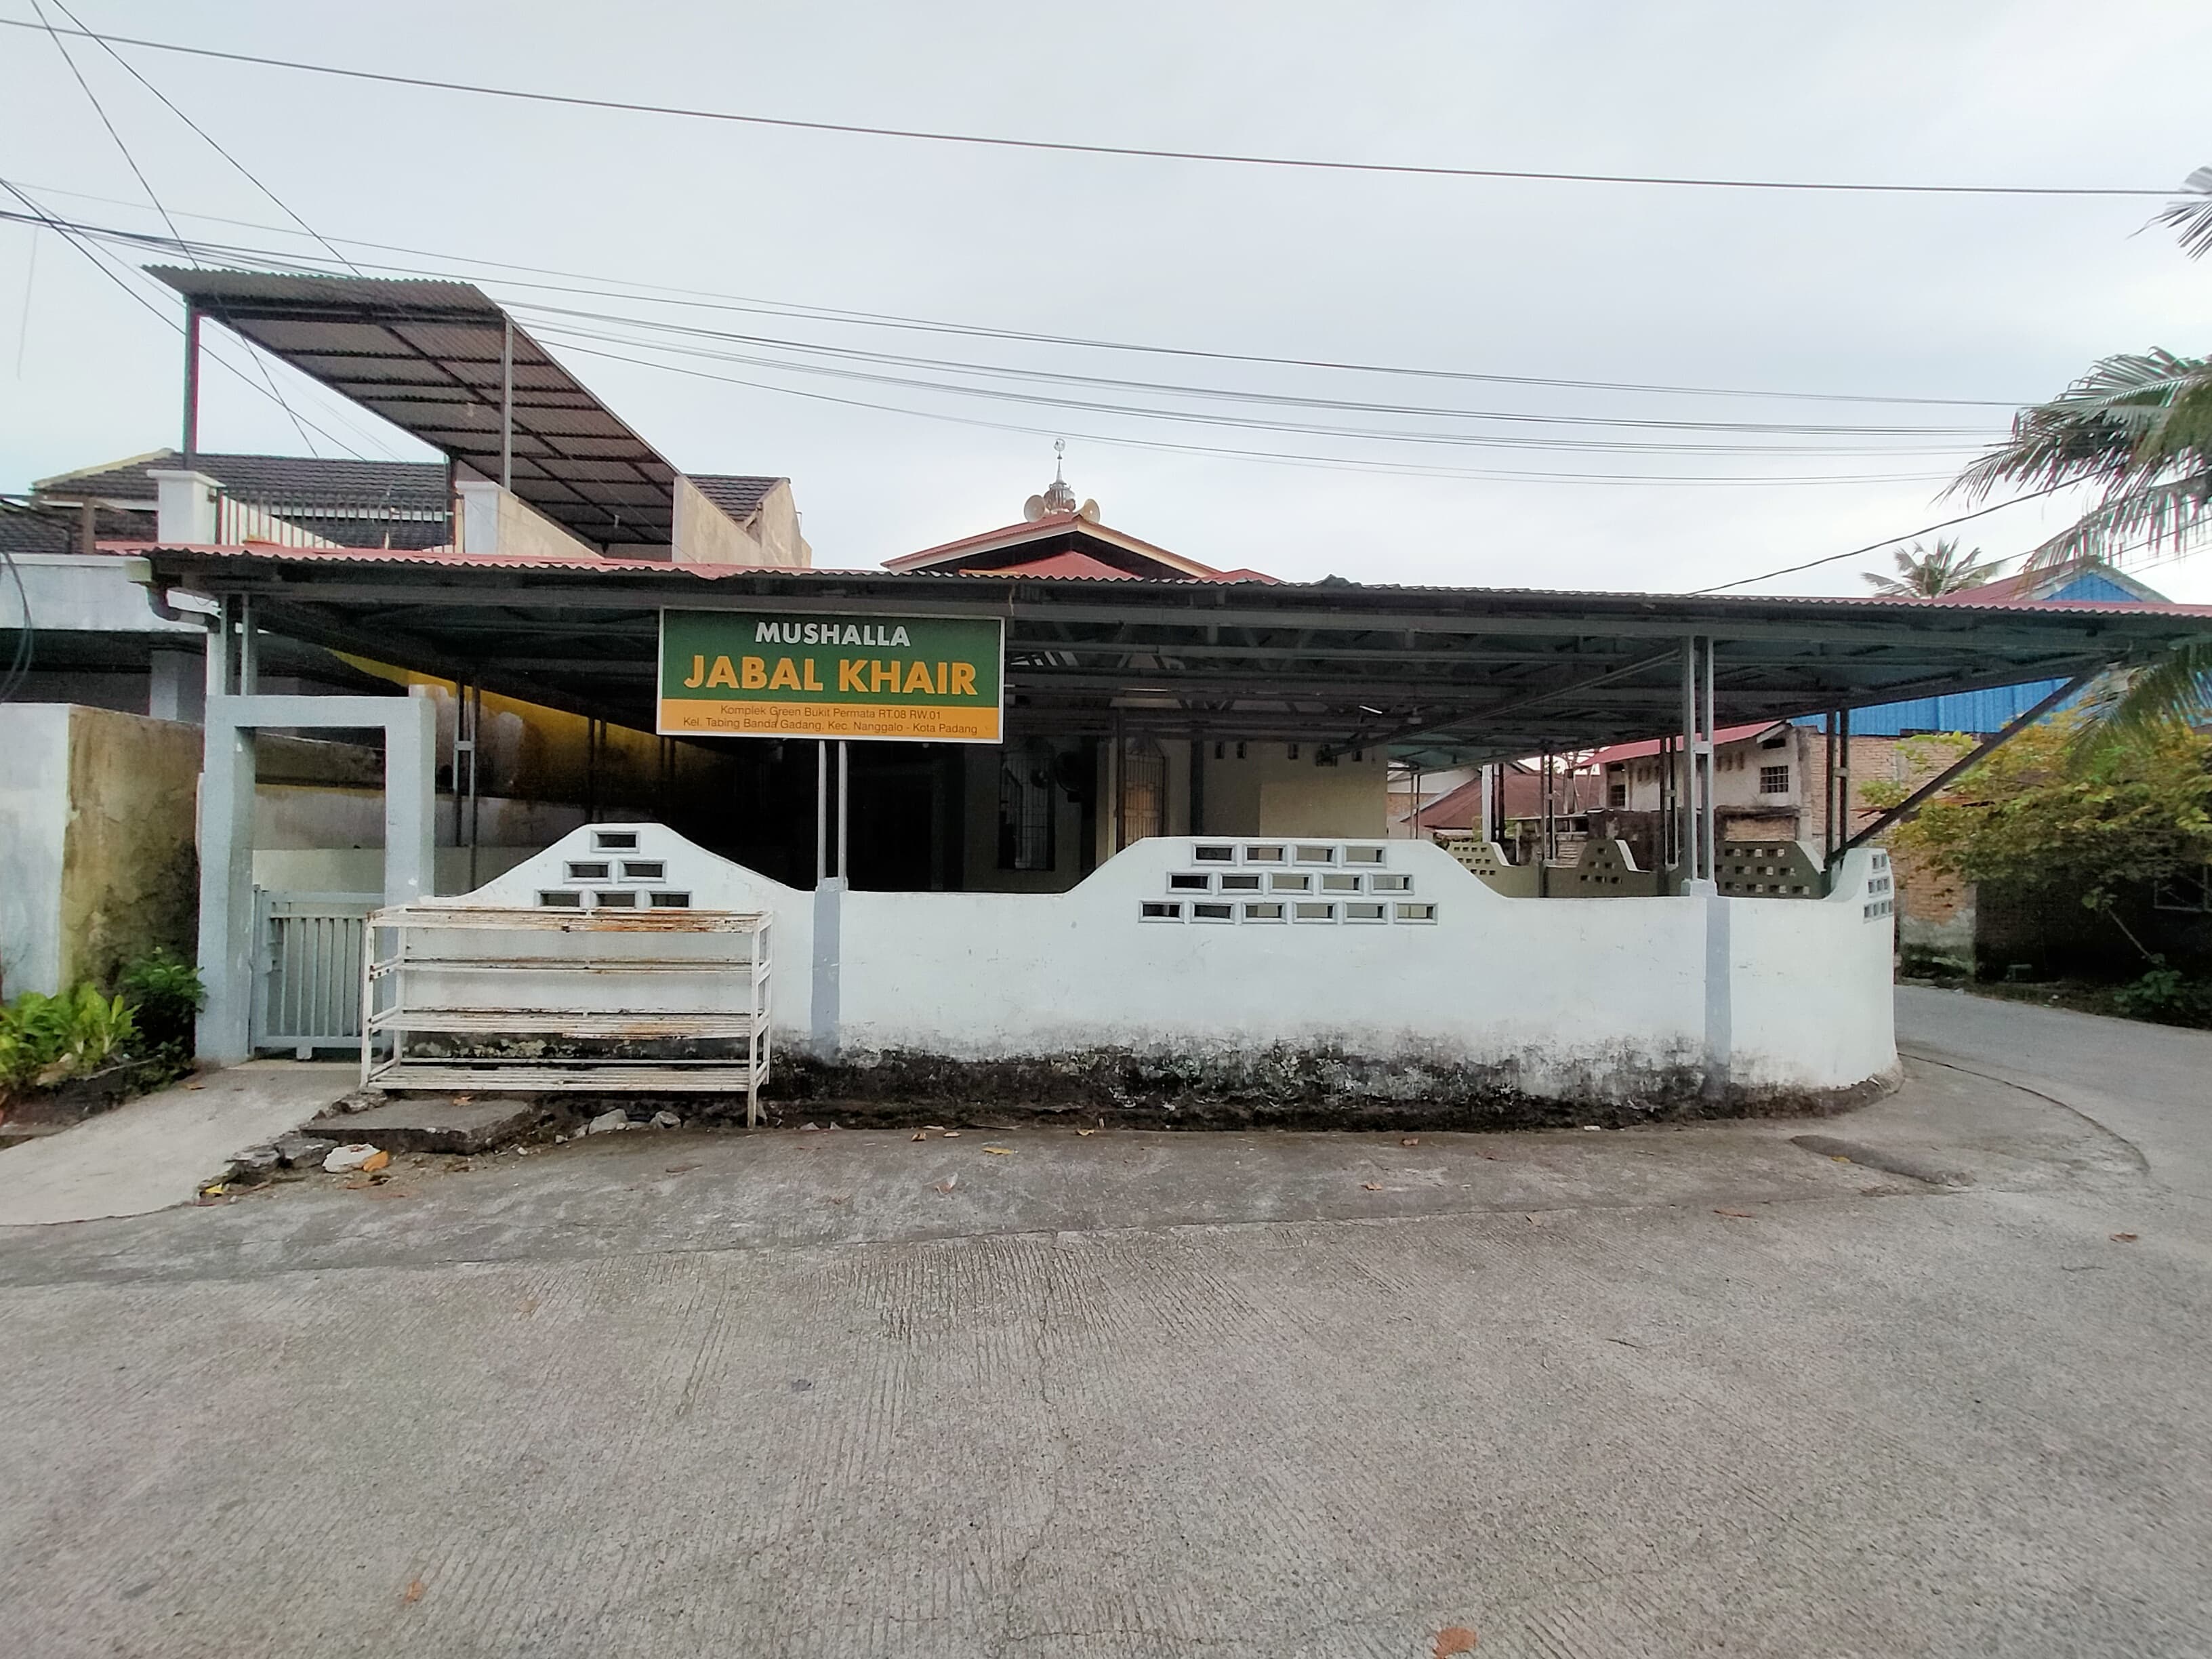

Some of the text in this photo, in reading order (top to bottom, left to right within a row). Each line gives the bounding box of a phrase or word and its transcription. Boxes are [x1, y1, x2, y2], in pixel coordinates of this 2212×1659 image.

[754, 621, 911, 647] MUSHALLA
[683, 655, 978, 695] JABAL KHAIR
[720, 705, 941, 720] Komplek Green Bukit Permata RT.08 RW.01
[705, 717, 740, 730] Tabing
[743, 718, 777, 729] Banda
[853, 721, 903, 733] Nanggalo
[913, 722, 936, 733] Kota
[939, 723, 978, 736] Padang
